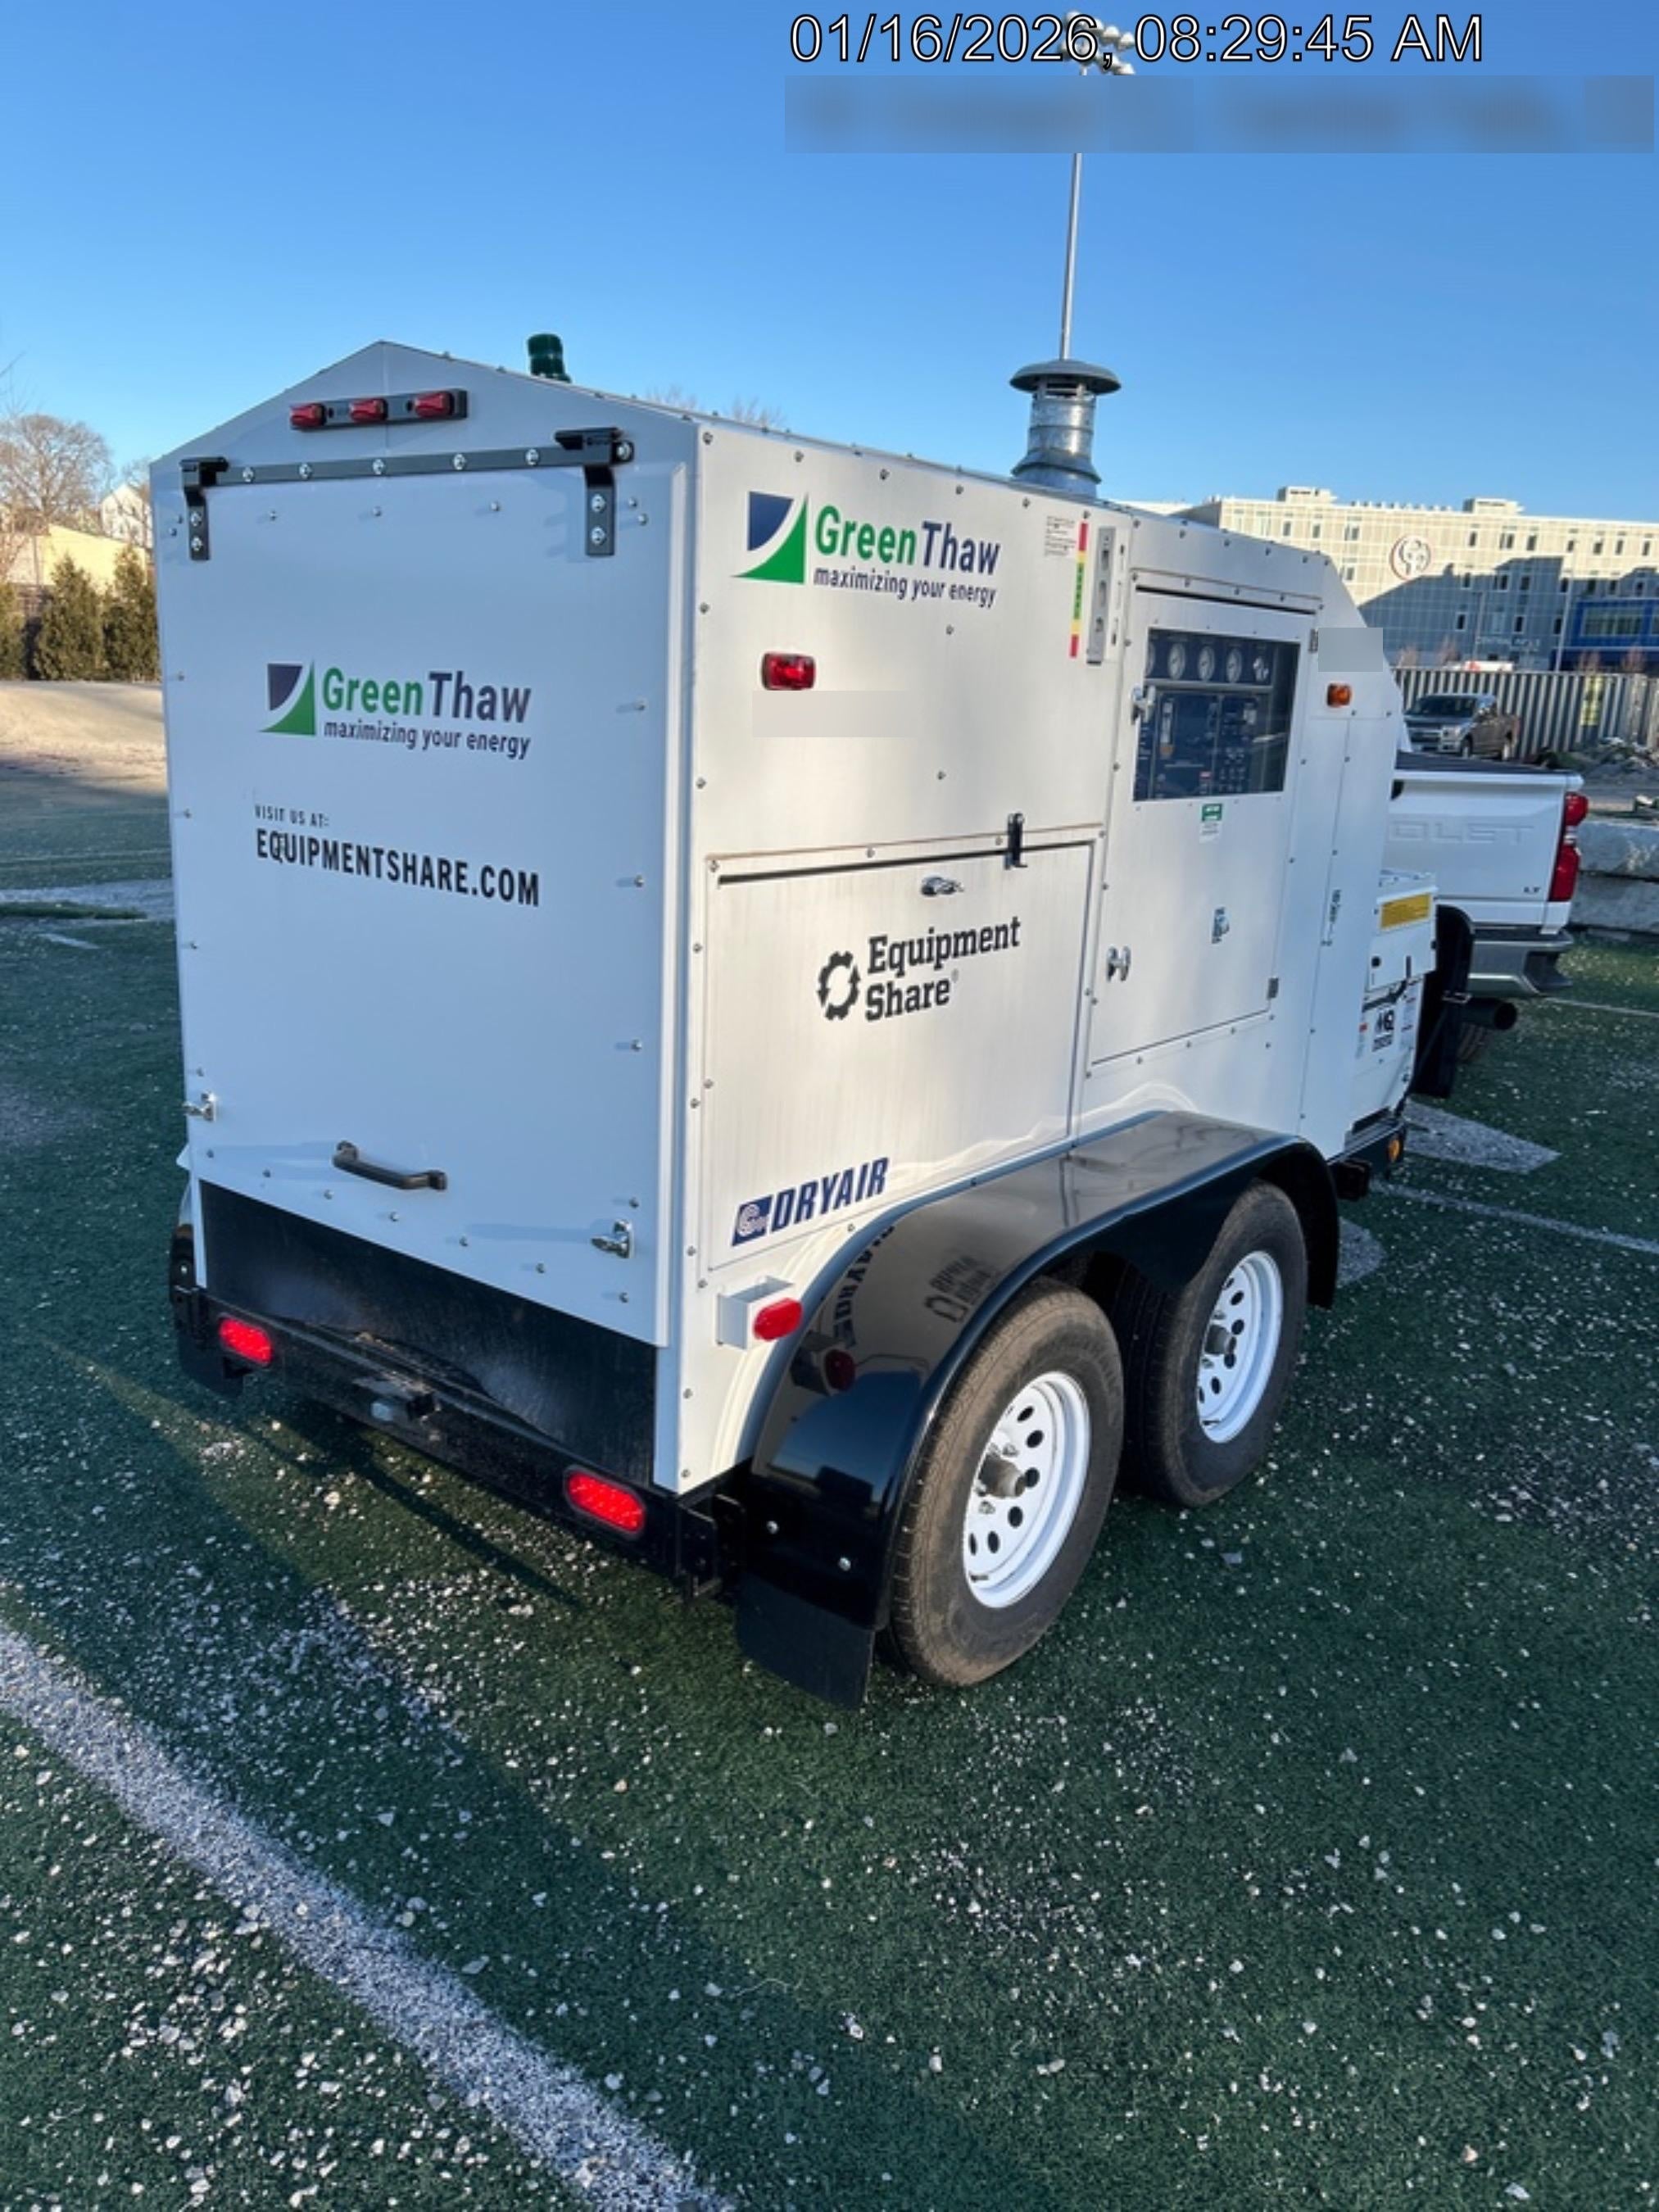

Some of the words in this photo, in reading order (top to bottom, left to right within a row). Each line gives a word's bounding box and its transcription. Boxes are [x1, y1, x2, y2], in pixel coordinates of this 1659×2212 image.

[814, 566, 908, 599] maximizing
[909, 576, 945, 602] your
[949, 582, 996, 609] energy
[324, 718, 417, 750] maximizing
[422, 728, 462, 751] your
[466, 732, 531, 760] energy
[254, 805, 285, 823] VISIT
[289, 809, 306, 827] US
[310, 811, 331, 827] AT:
[256, 827, 540, 907] EQUIPMENTSHARE.COM
[867, 915, 1021, 978] Equipment
[864, 978, 951, 1022] Share
[771, 1157, 889, 1233] DRYAIR
